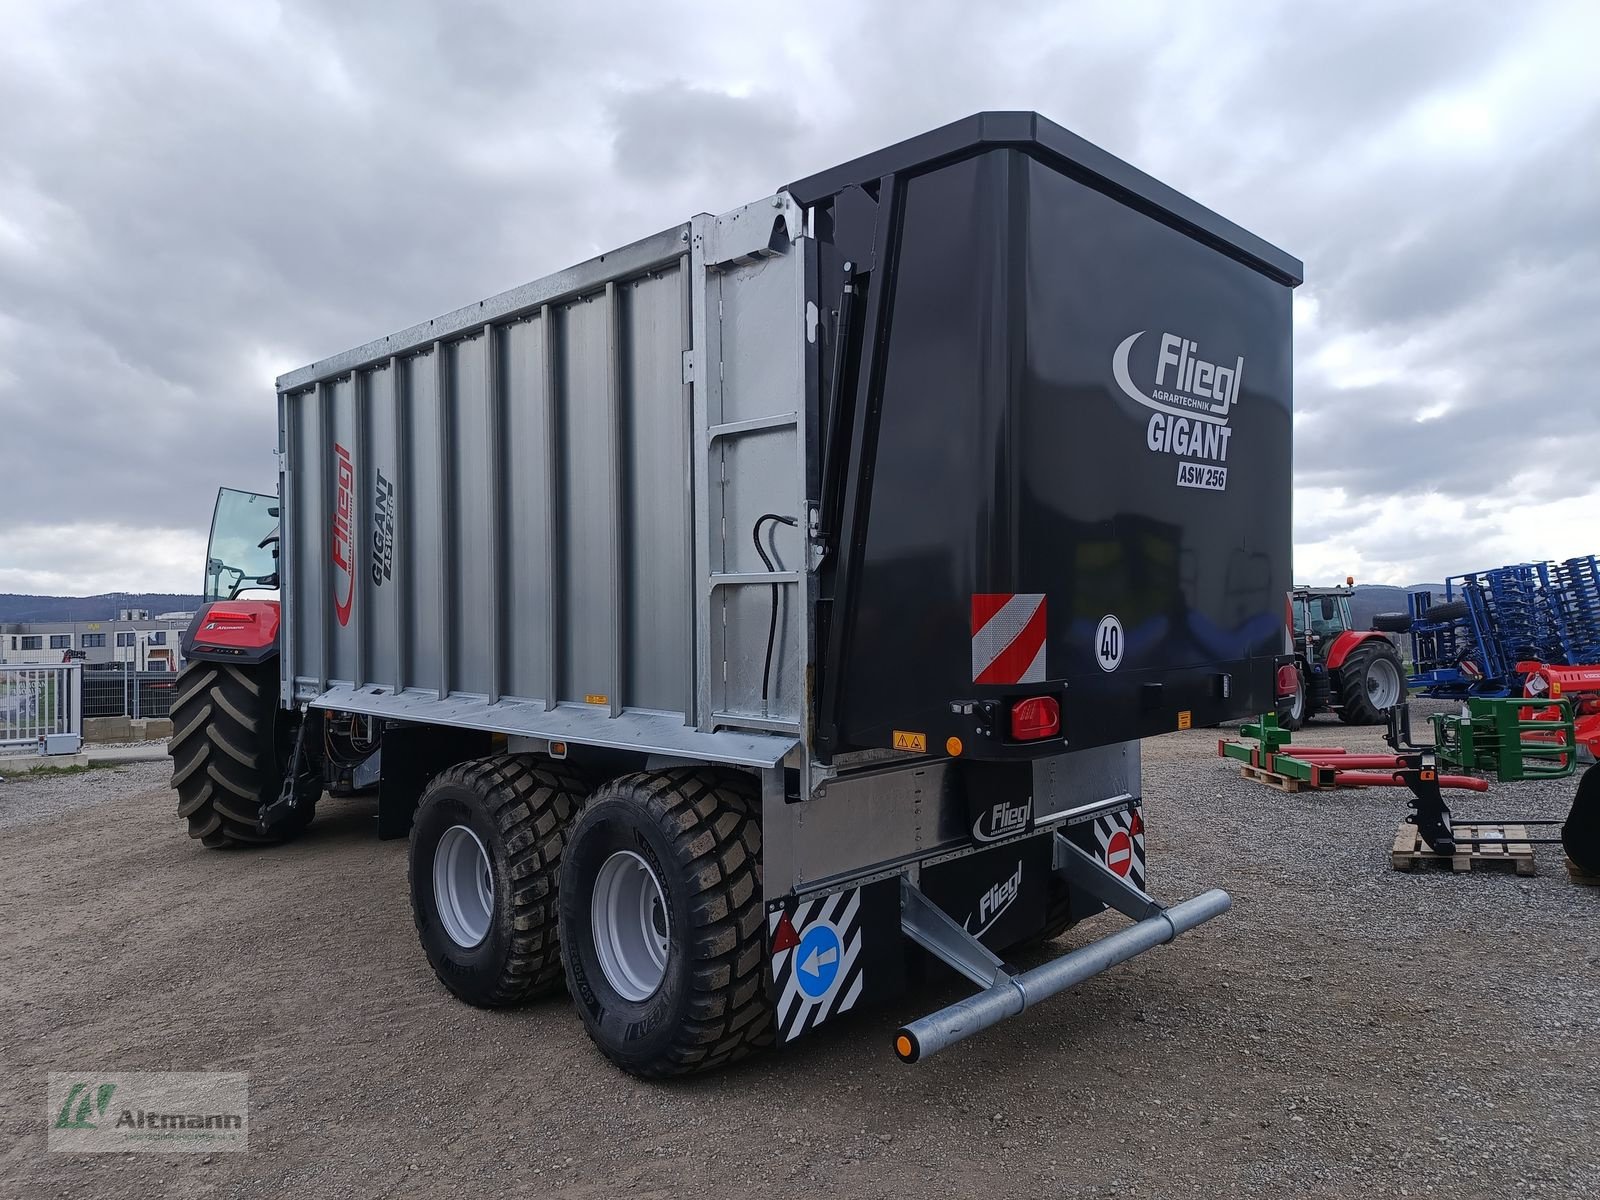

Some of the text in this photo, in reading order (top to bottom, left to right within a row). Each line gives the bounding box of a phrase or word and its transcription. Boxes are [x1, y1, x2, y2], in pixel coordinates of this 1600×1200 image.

[1152, 389, 1210, 411] AGRARTECHNIK
[1155, 332, 1244, 415] Fliegl
[1147, 413, 1232, 461] GIGANT
[1179, 465, 1224, 487] ASW 256
[332, 443, 353, 571] Fliegl
[372, 468, 388, 587] GIGANT
[383, 494, 394, 570] ASW 256
[1100, 625, 1118, 661] 40
[991, 796, 1032, 830] Fliegl
[980, 859, 1022, 924] Fliegl
